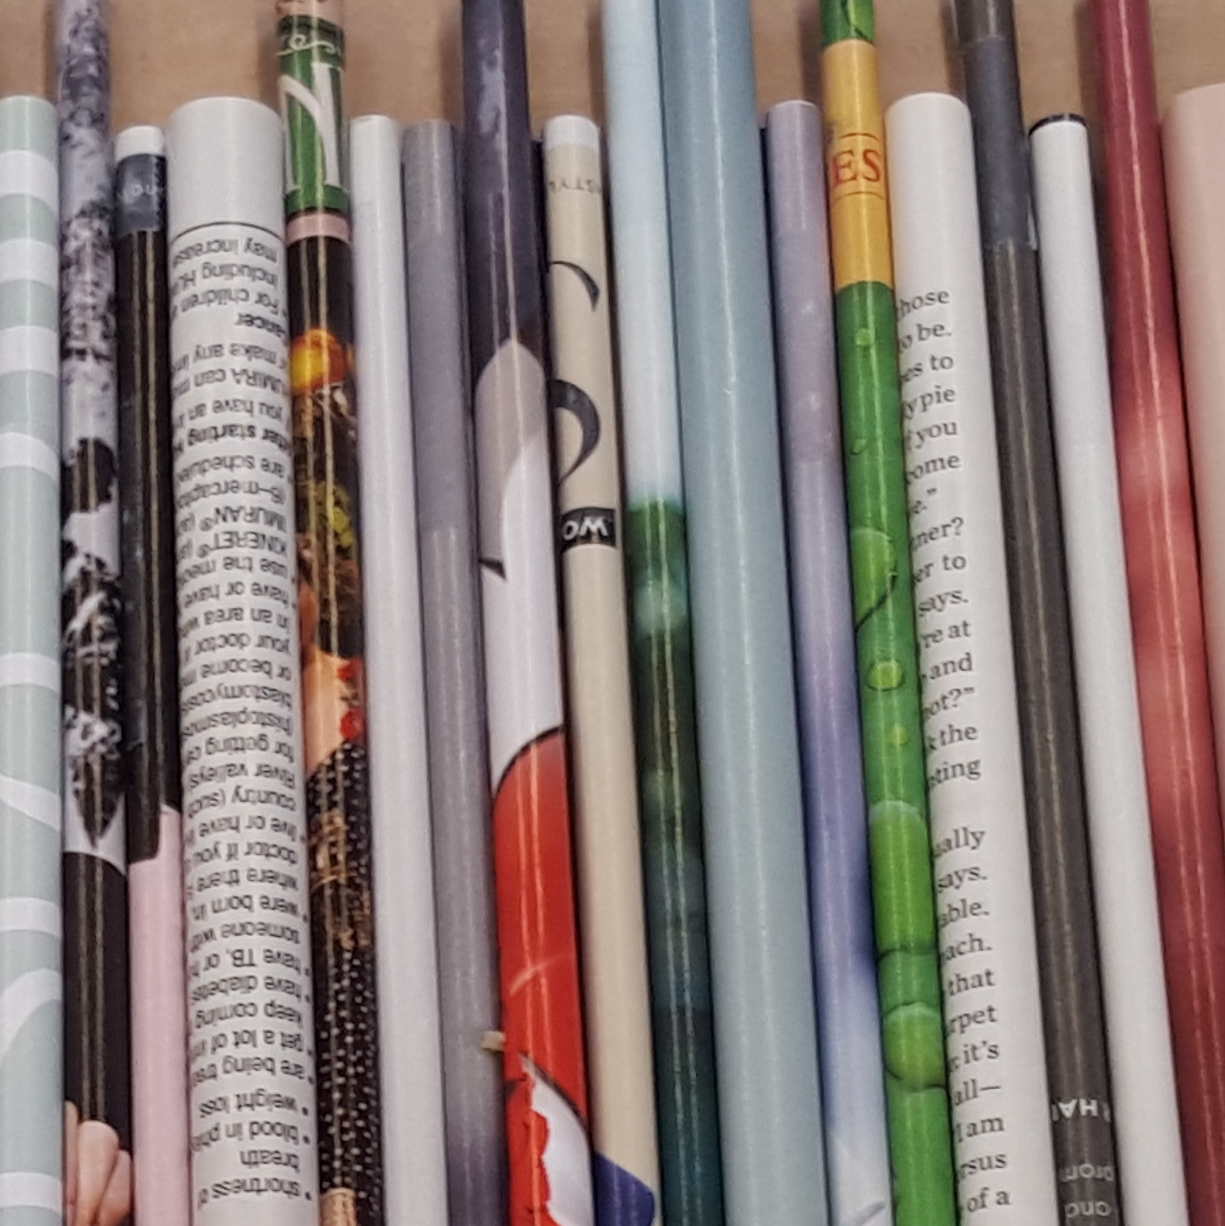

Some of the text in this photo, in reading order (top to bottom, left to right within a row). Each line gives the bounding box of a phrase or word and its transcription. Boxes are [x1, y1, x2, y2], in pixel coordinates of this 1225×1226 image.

[917, 323, 952, 340] be.
[930, 354, 954, 371] to
[921, 388, 956, 413] pie
[914, 421, 958, 451] you
[942, 554, 966, 571] to
[948, 620, 972, 639] at
[929, 653, 973, 680] and
[206, 733, 270, 757] getting
[940, 723, 978, 747] the
[232, 786, 296, 811] country
[247, 869, 298, 890] where
[212, 895, 298, 917] were born
[222, 922, 300, 944] someone
[947, 968, 996, 997] that
[224, 1056, 274, 1074] being
[200, 1088, 297, 1117] weight loss
[226, 1121, 298, 1144] blood in
[966, 1117, 1005, 1137] am
[240, 1150, 300, 1172] breath
[211, 1179, 300, 1200] shortness
[967, 1187, 1011, 1213] of a
